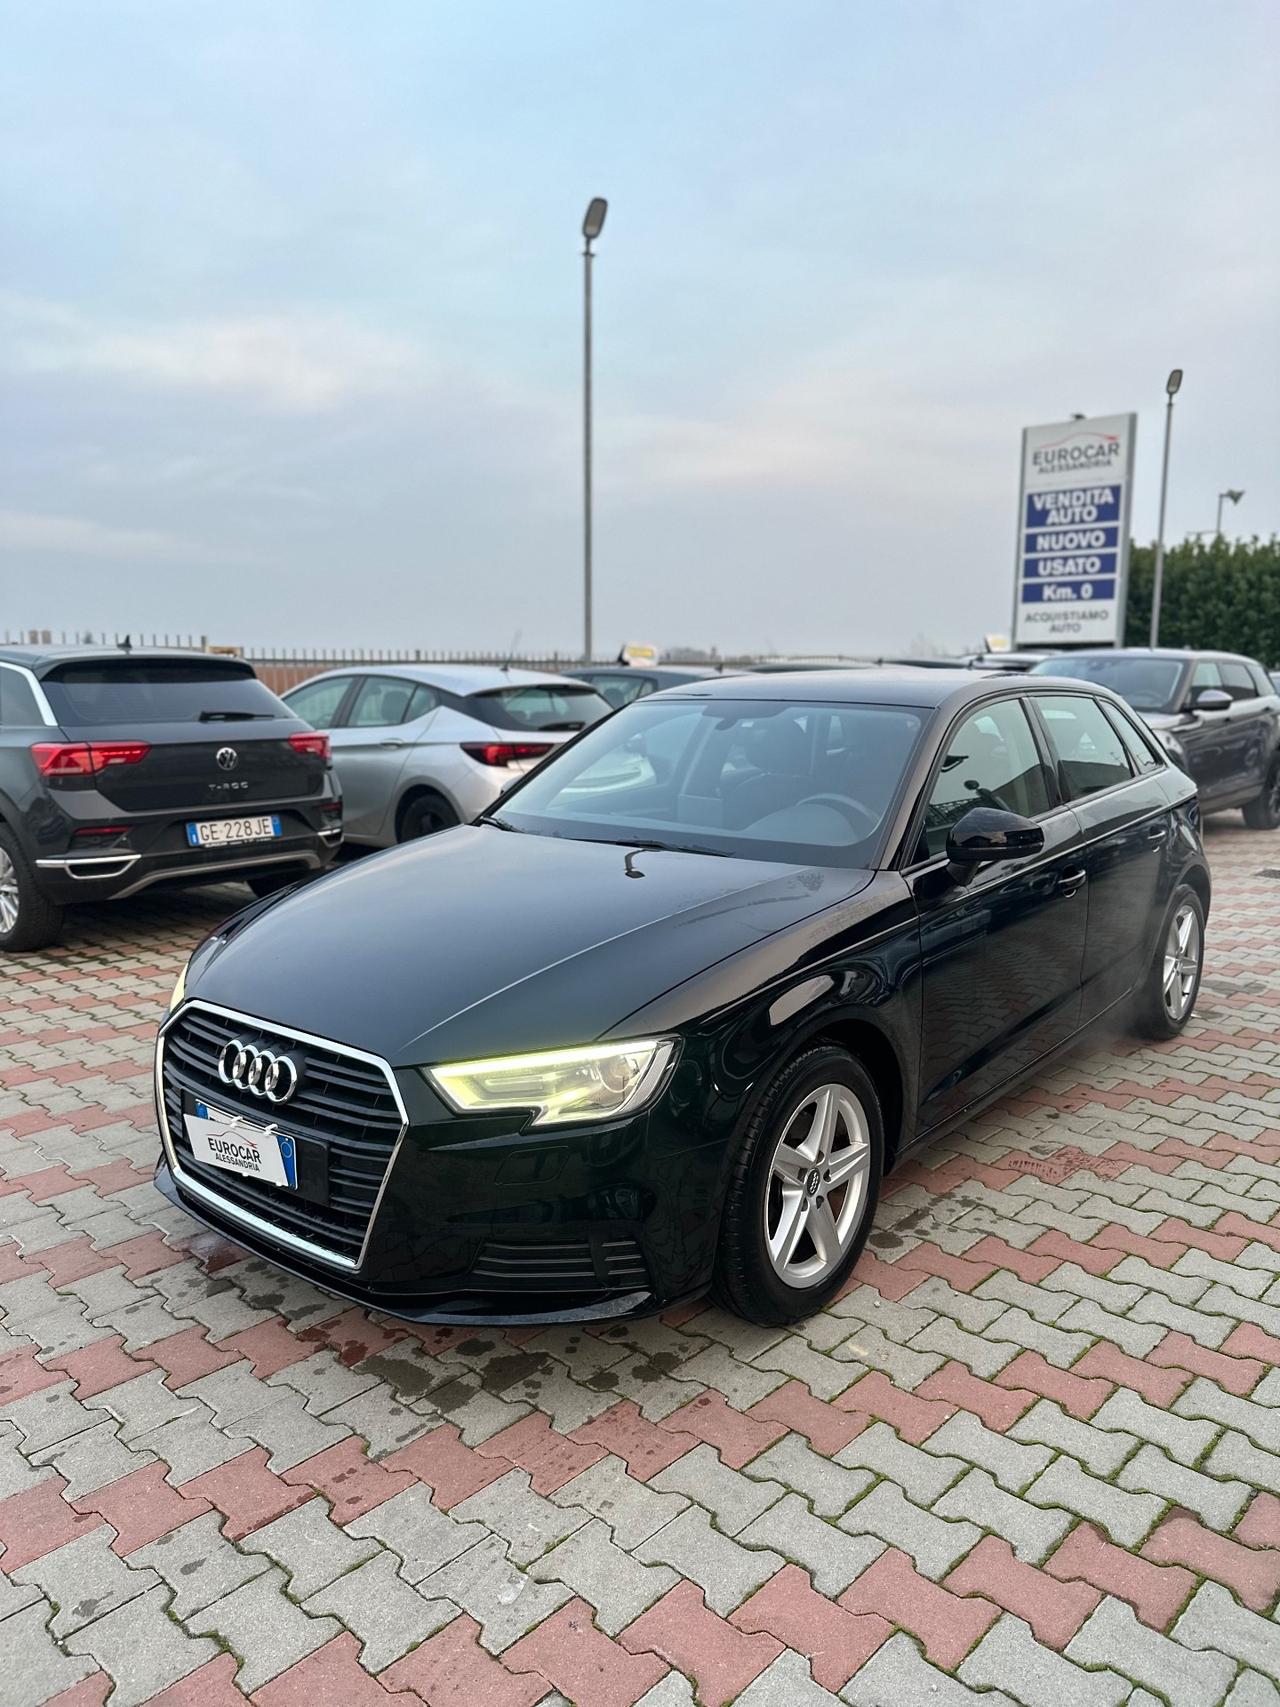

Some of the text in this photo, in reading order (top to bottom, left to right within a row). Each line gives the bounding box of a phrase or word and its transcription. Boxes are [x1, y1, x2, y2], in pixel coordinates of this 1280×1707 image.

[1033, 442, 1119, 466] EUROCAR
[1038, 459, 1112, 474] ALESSANDRIA
[1033, 488, 1113, 511] VENDITA
[1046, 506, 1097, 525] AUTO
[1036, 531, 1105, 551] NUOVO
[1038, 557, 1100, 576] USATO
[1042, 583, 1092, 600] Km. 0
[1025, 610, 1108, 623] ACQUISTIAMO
[1049, 623, 1082, 634] AUTO
[208, 1137, 262, 1164] EUROCAR
[215, 1152, 260, 1172] ALESSANDRIA
